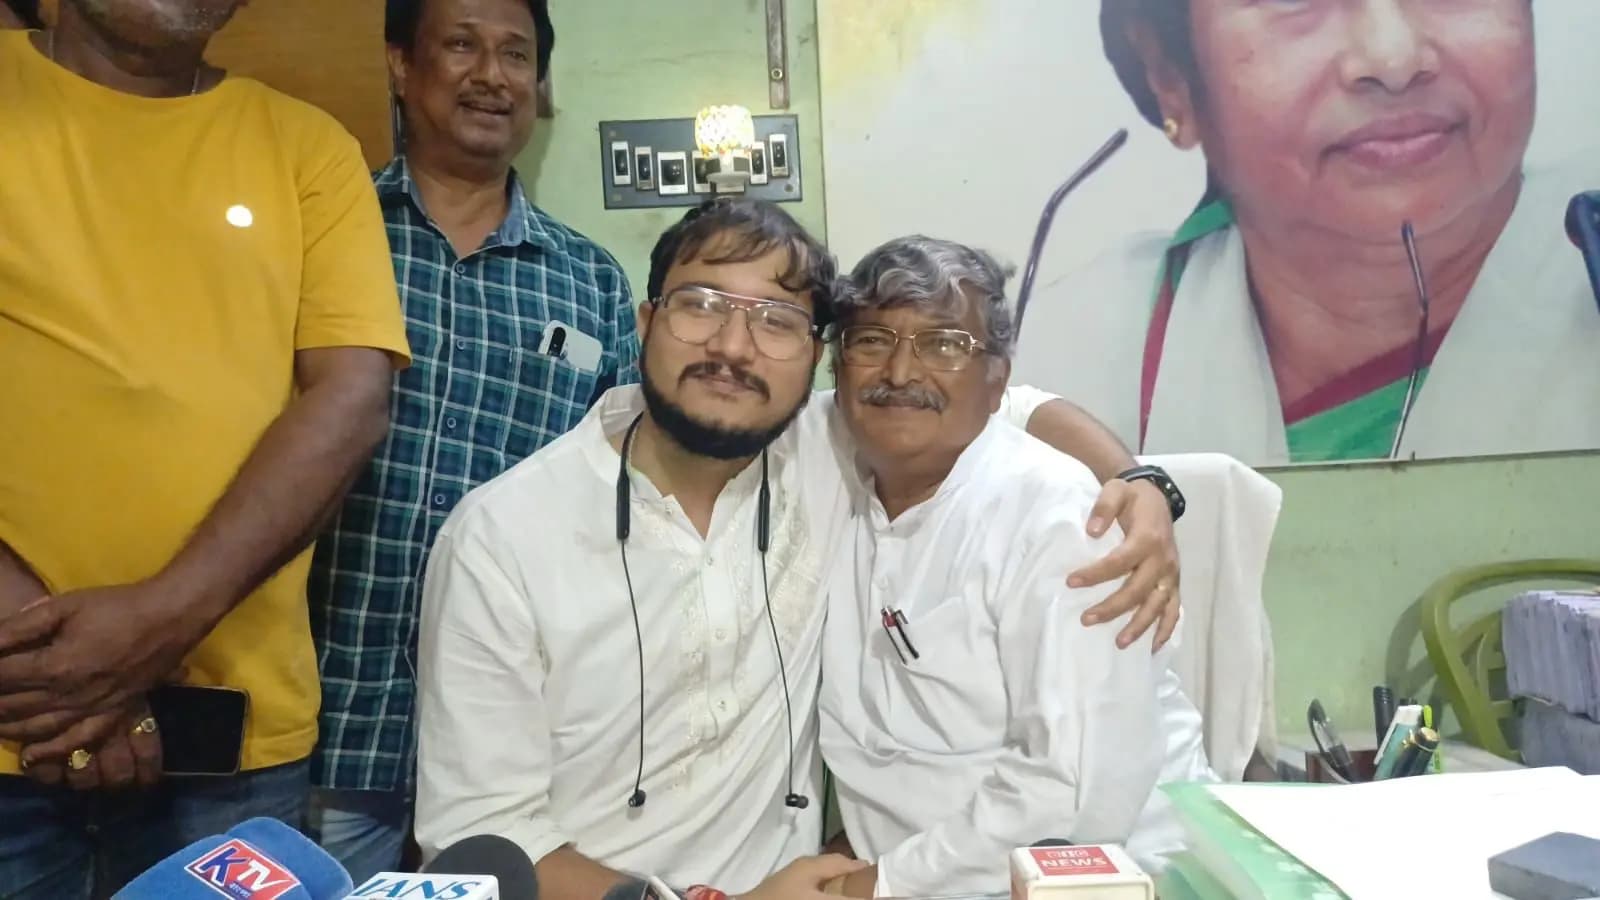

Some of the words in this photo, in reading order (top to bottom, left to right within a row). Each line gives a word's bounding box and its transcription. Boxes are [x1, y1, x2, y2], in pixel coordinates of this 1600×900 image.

[194, 846, 291, 892] KTV
[1041, 857, 1108, 867] NEWS
[351, 878, 481, 900] IANS
